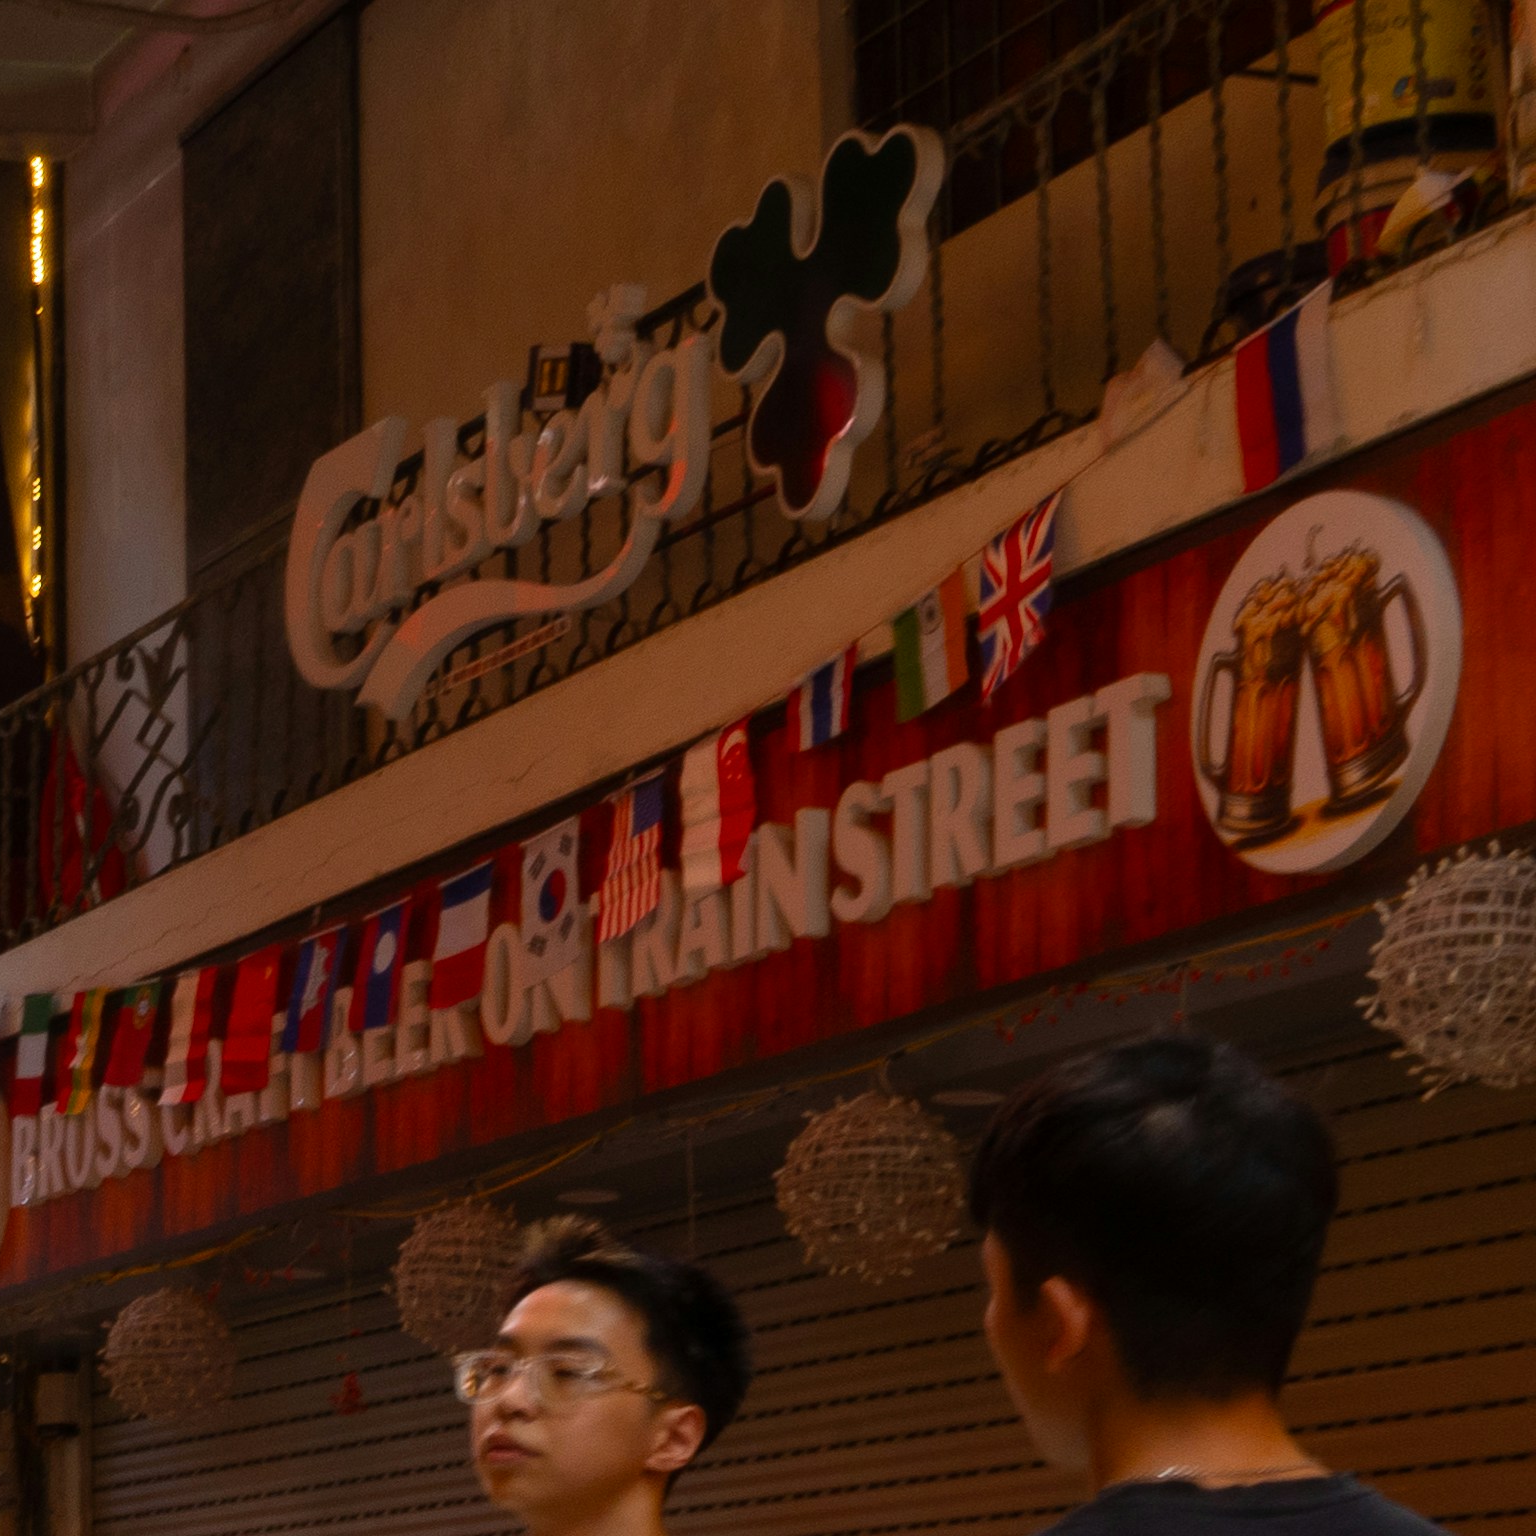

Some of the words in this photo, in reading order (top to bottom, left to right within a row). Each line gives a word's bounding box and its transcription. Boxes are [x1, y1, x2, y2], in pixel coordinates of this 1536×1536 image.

[285, 284, 712, 716] Carlsberg
[10, 1068, 163, 1208] BROSS
[830, 671, 1172, 924] STREET
